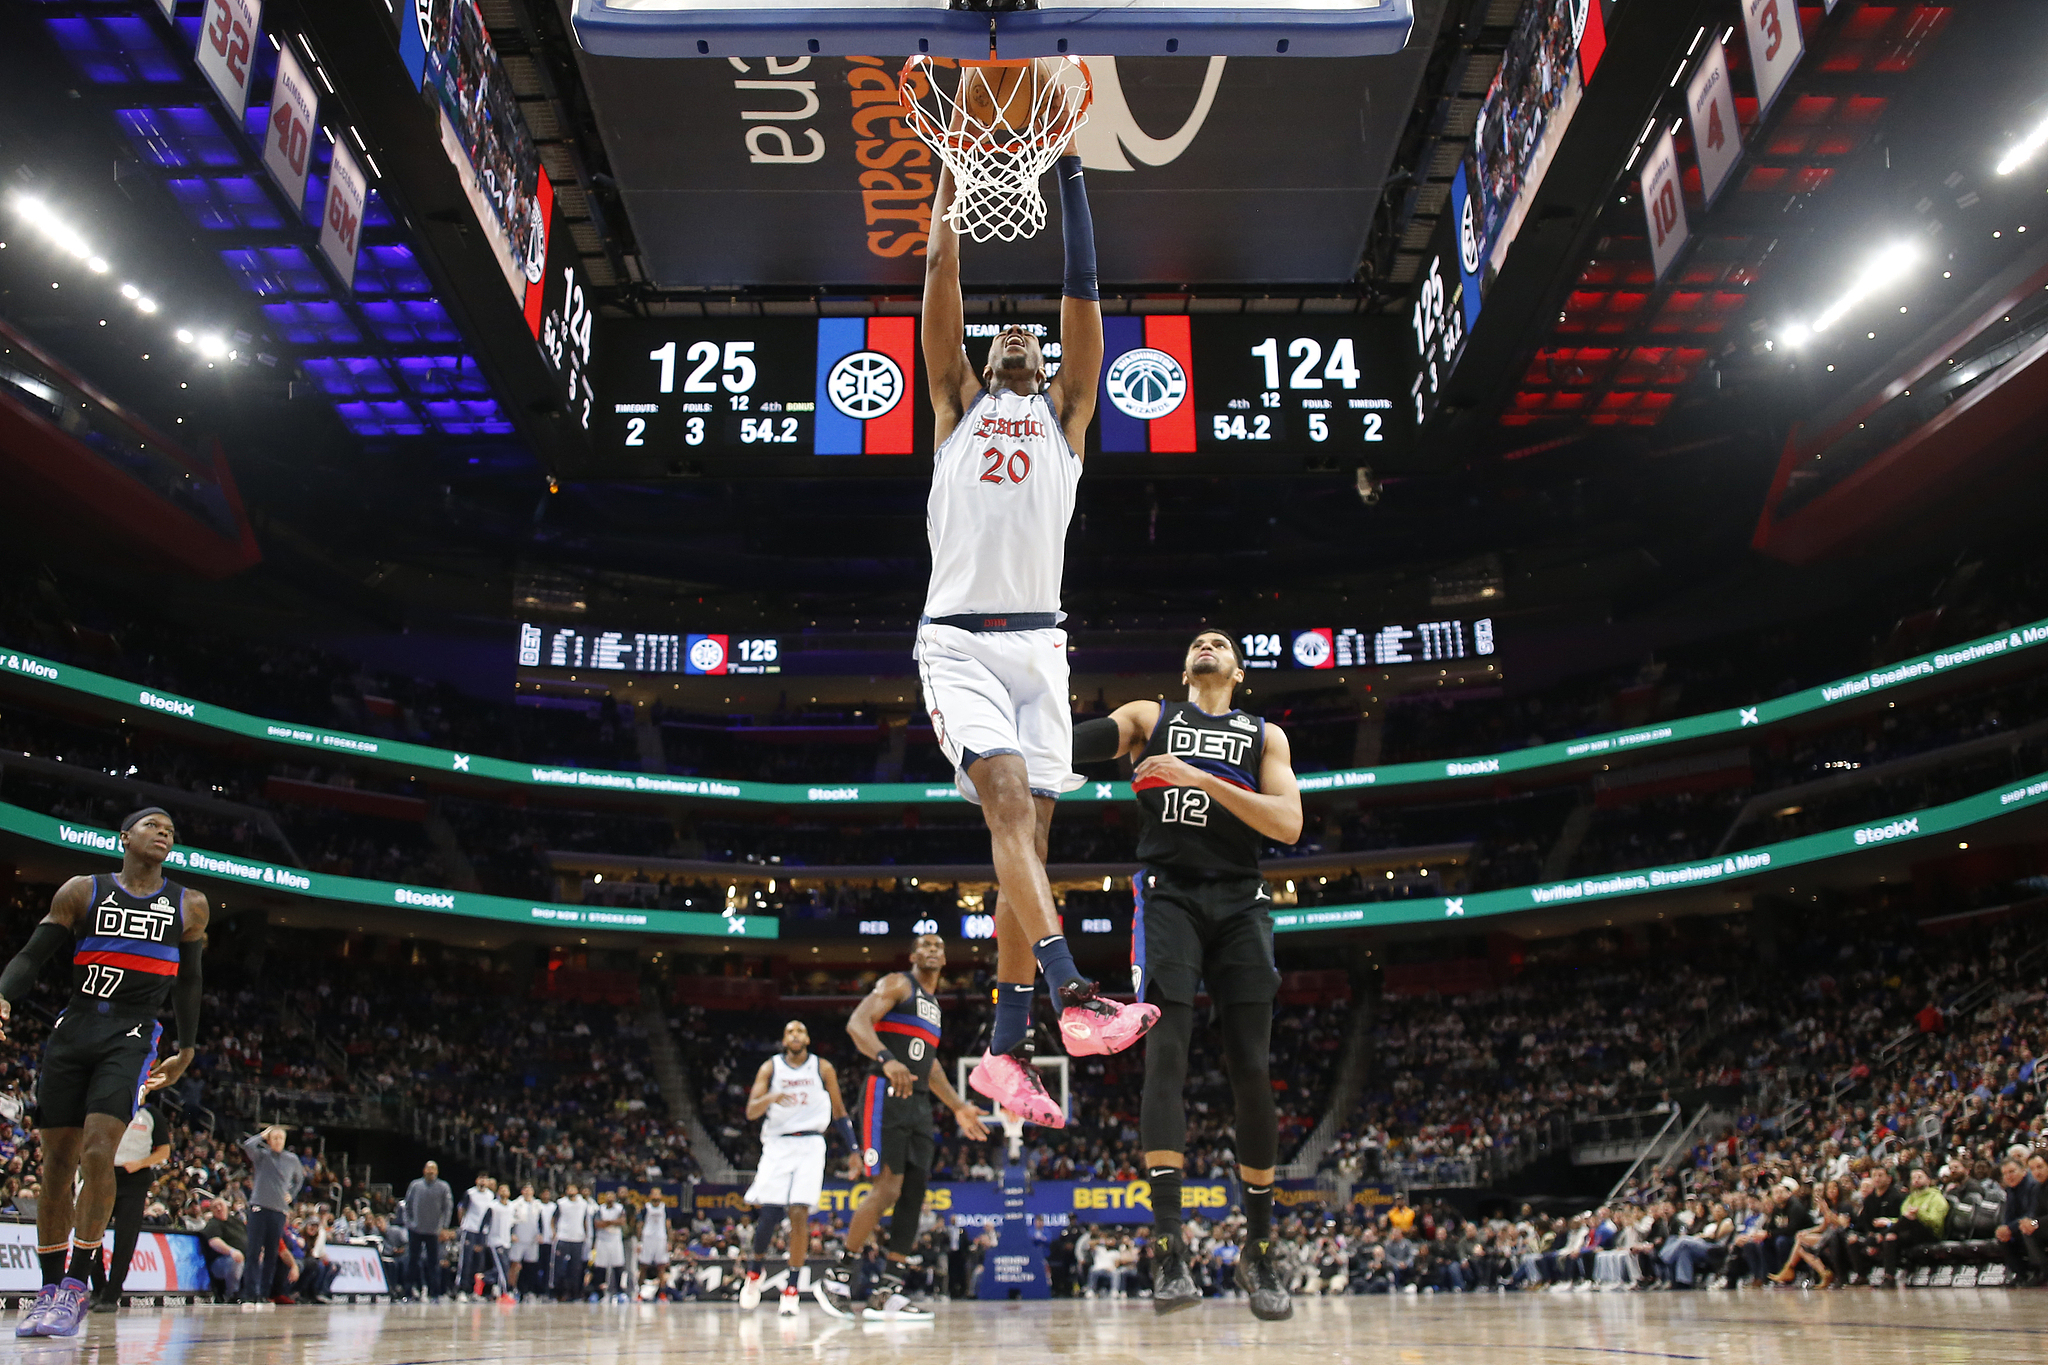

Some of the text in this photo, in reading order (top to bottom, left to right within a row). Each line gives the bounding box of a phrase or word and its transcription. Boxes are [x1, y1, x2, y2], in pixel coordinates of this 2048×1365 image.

[1761, 0, 1782, 62] 3
[208, 0, 250, 89] 32
[1707, 98, 1725, 153] 4
[273, 101, 307, 177] 40
[845, 55, 957, 258] aesars
[329, 185, 358, 256] GM
[1652, 178, 1677, 248] 10
[966, 325, 999, 337] TEAM
[1042, 342, 1062, 358] 48
[1115, 350, 1177, 372] WASHINGTON
[650, 341, 757, 393] 125
[1251, 338, 1361, 390] 124
[614, 403, 659, 413] TIMEOUTS:
[682, 403, 713, 413] FOULS:
[730, 395, 749, 411] 12
[760, 401, 815, 412] 4th BONUS
[1227, 398, 1251, 410] 4th
[1260, 392, 1281, 408] 12
[1301, 398, 1333, 410] FOULS:
[1347, 398, 1393, 410] TIMEOUTS:
[625, 417, 646, 446] 2
[685, 416, 705, 446] 3
[740, 417, 799, 444] 54.2
[1213, 415, 1272, 441] 54.2
[1308, 413, 1329, 443] 5
[1363, 413, 1383, 442] 2
[980, 447, 1032, 485] 20
[519, 622, 542, 667] DET
[737, 638, 778, 661] 125
[1241, 634, 1282, 657] 124
[7, 655, 20, 669] &
[22, 658, 58, 680] More
[1821, 676, 1870, 701] Verified
[1870, 661, 1934, 689] Sneakers,
[1934, 638, 2008, 669] Streetwear
[2009, 632, 2022, 648] &
[139, 691, 195, 717] StockX
[267, 725, 292, 738] SHOP
[292, 730, 314, 742] NOW
[322, 735, 378, 753] STOCKX.COM
[1168, 725, 1253, 765] DET
[1566, 743, 1590, 756] SHOP
[1590, 739, 1610, 751] NOW
[1618, 727, 1673, 747] STOCKX.COM
[1333, 774, 1344, 787] &
[1345, 772, 1376, 786] More
[1446, 758, 1500, 777] StockX
[532, 768, 741, 796] Verified Sneakers, Streetwear & More
[807, 788, 859, 800] StockX
[1162, 788, 1210, 827] 12
[2001, 788, 2026, 805] SHOP
[1854, 817, 1919, 845] StockX
[59, 824, 116, 851] Verified
[188, 852, 263, 881] Streetwear
[263, 867, 275, 883] &
[276, 869, 310, 890] More
[1531, 852, 1771, 903] Verified Sneakers, Streetwear & More
[394, 888, 454, 910] StockX
[95, 906, 173, 942] DET
[531, 907, 556, 918] SHOP
[557, 910, 578, 921] NOW
[588, 912, 647, 925] STOCKX.COM
[859, 920, 889, 934] REB
[912, 919, 939, 935] 40
[1082, 918, 1112, 933] REB
[1306, 910, 1364, 924] STOCKX.COM
[82, 964, 124, 998] 17
[917, 997, 941, 1028] DE
[908, 1037, 925, 1061] 0
[1073, 1180, 1227, 1213] BETRERS
[129, 1296, 155, 1308] StockX
[162, 1296, 187, 1308] StockX
